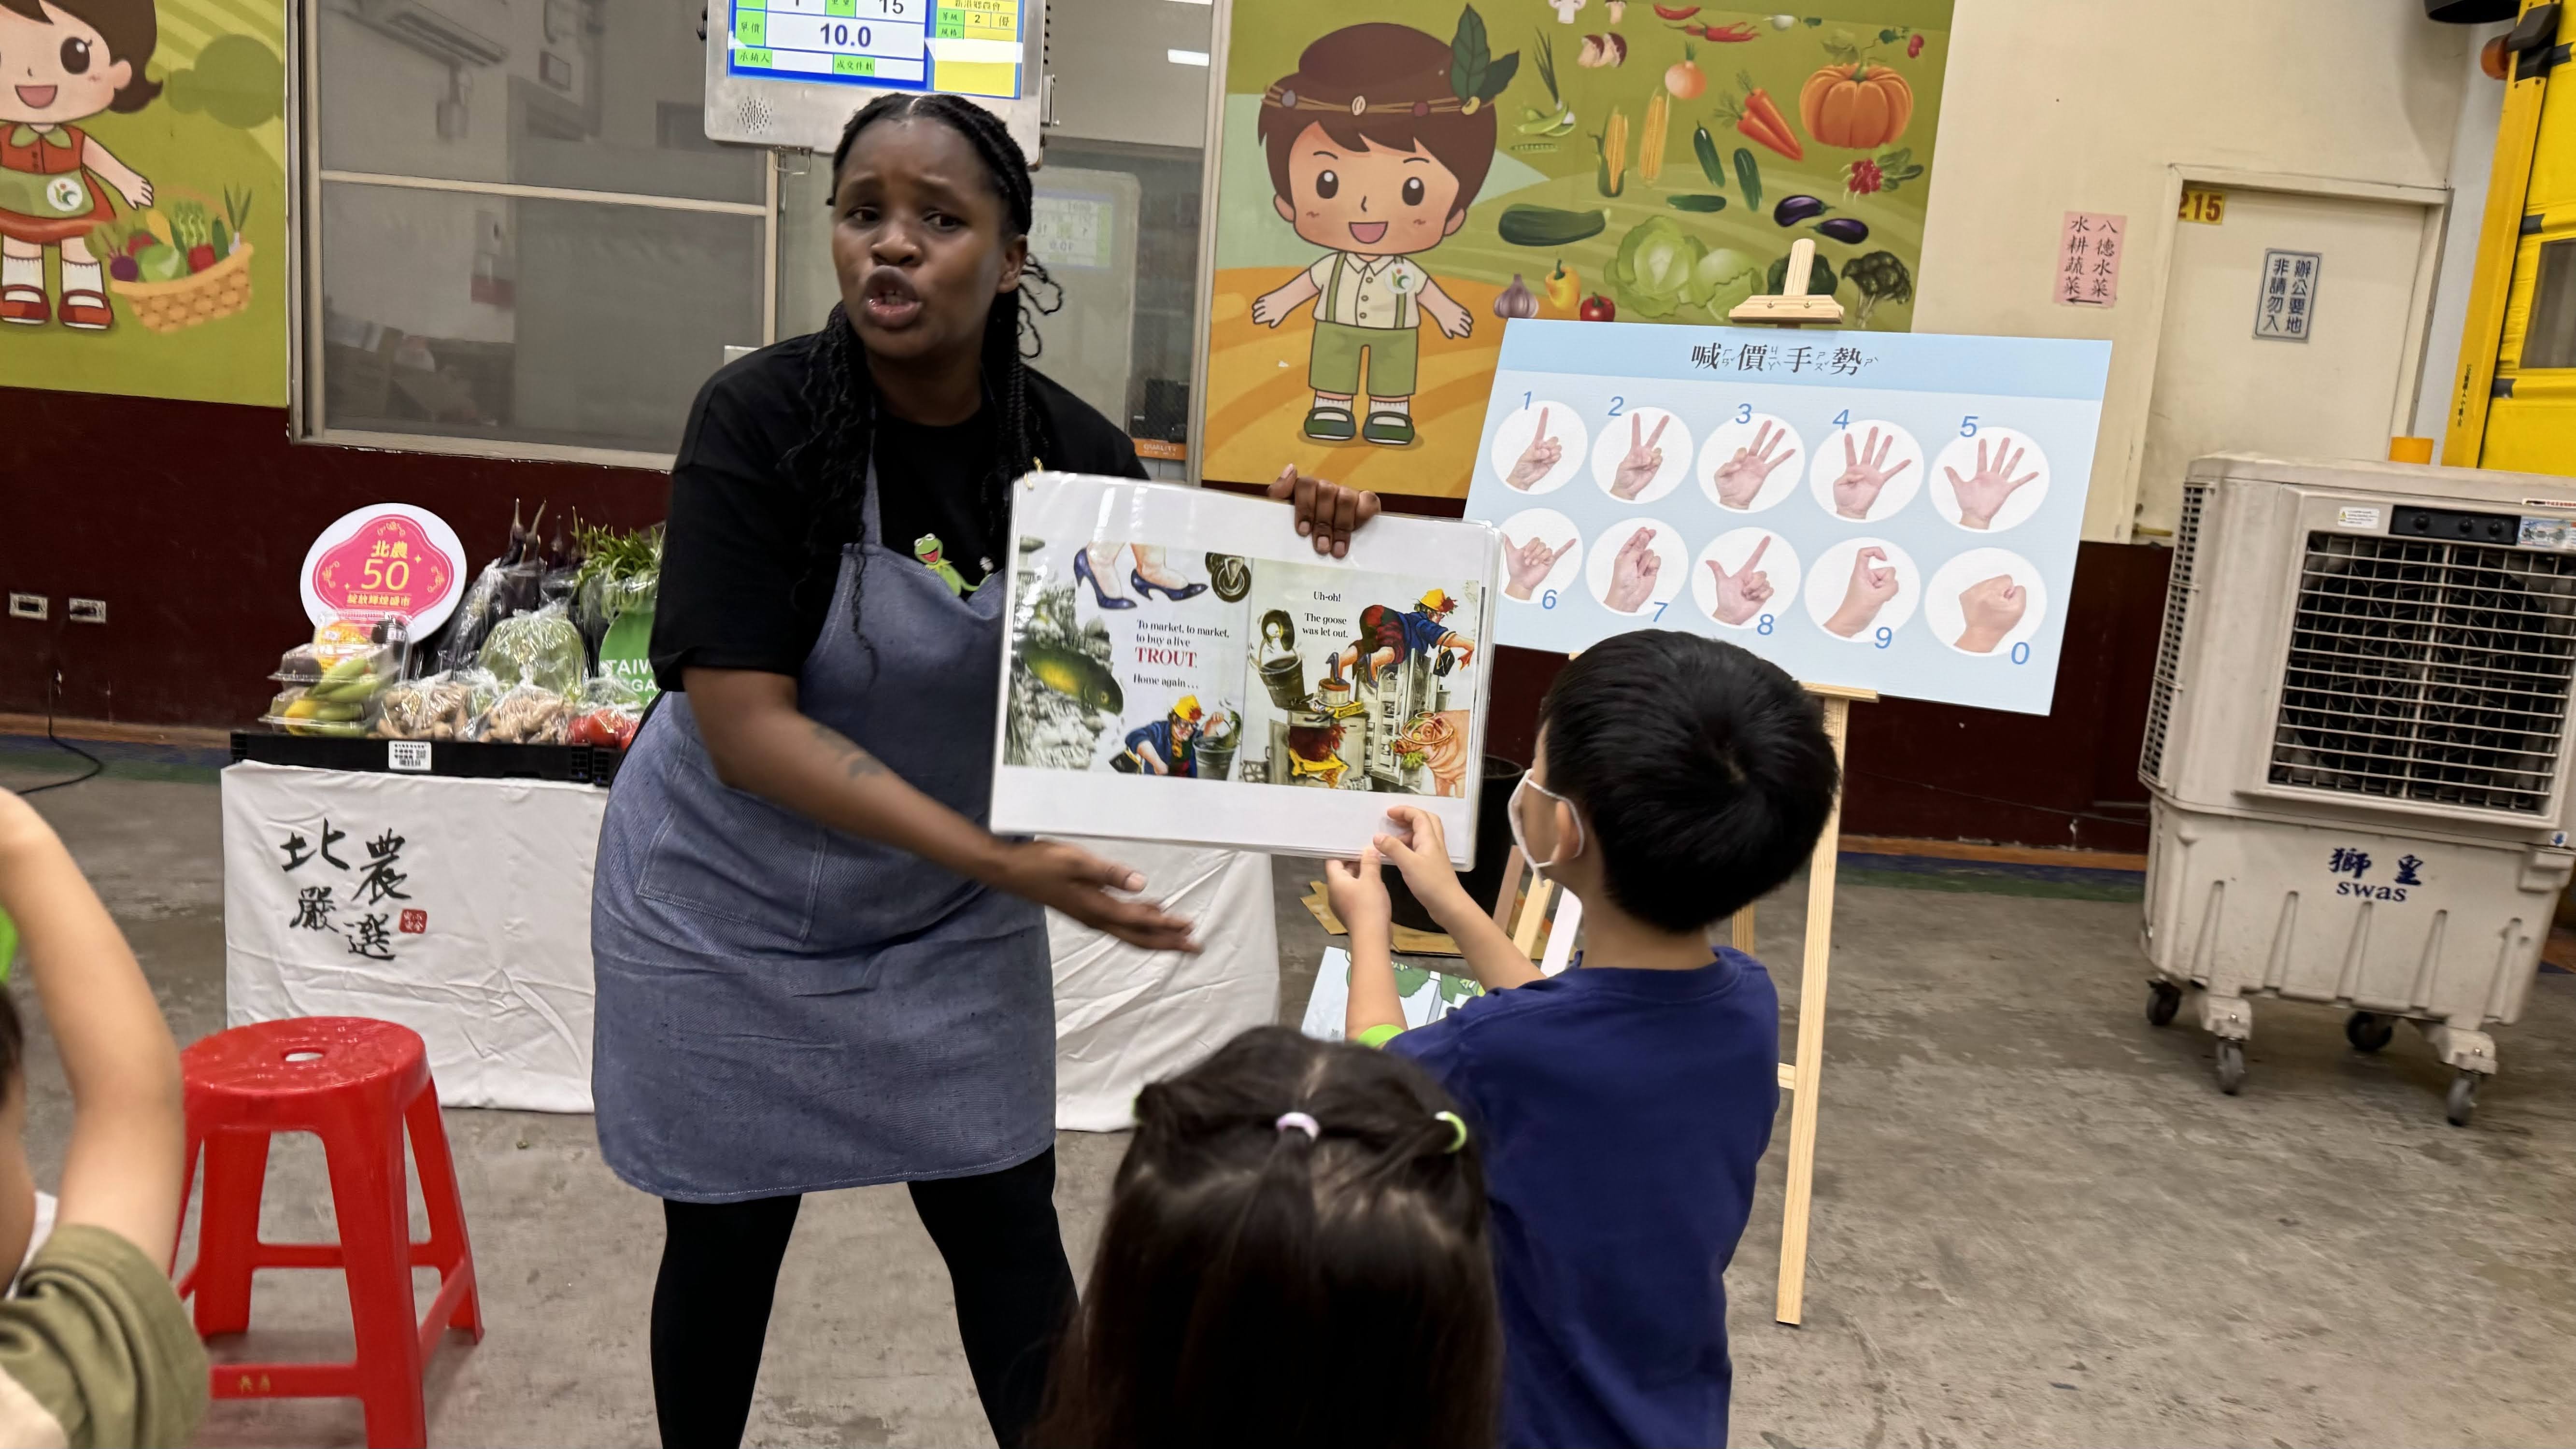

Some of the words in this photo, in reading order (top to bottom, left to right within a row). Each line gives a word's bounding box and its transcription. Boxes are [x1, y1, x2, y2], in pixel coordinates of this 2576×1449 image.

[975, 14, 981, 23] 2
[820, 23, 871, 47] 10.0
[2063, 216, 2090, 295] 水耕蔬菜
[2263, 258, 2290, 332] 非請勿入
[1691, 342, 1863, 376] 喊價手勢
[1523, 391, 1532, 410] 1
[1608, 396, 1624, 417] 2
[1735, 403, 1752, 424] 3
[1832, 409, 1850, 430] 4
[1959, 416, 1978, 438] 5
[371, 540, 408, 558] 北農
[361, 559, 410, 591] 50
[1313, 591, 1341, 602] Uh-oh!
[1541, 589, 1558, 610] 6
[1305, 612, 1321, 623] The
[1323, 616, 1347, 625] goose
[1653, 602, 1668, 623] 7
[1137, 619, 1148, 629] To
[1151, 622, 1184, 634] market,
[1187, 625, 1195, 634] to
[1197, 626, 1229, 638] market,
[1321, 627, 1331, 637] let
[1333, 629, 1348, 638] out.
[1757, 614, 1775, 636] 8
[1137, 633, 1145, 642] to
[1147, 633, 1164, 647] buy
[1167, 638, 1172, 646] a
[1174, 636, 1191, 648] live
[1874, 627, 1893, 649] 9
[1135, 646, 1197, 668] TROUT.
[2010, 641, 2030, 665] 0
[1133, 673, 1160, 685] Home
[279, 817, 412, 906] 北農
[2336, 881, 2407, 902] swas
[289, 886, 396, 960] 嚴選
